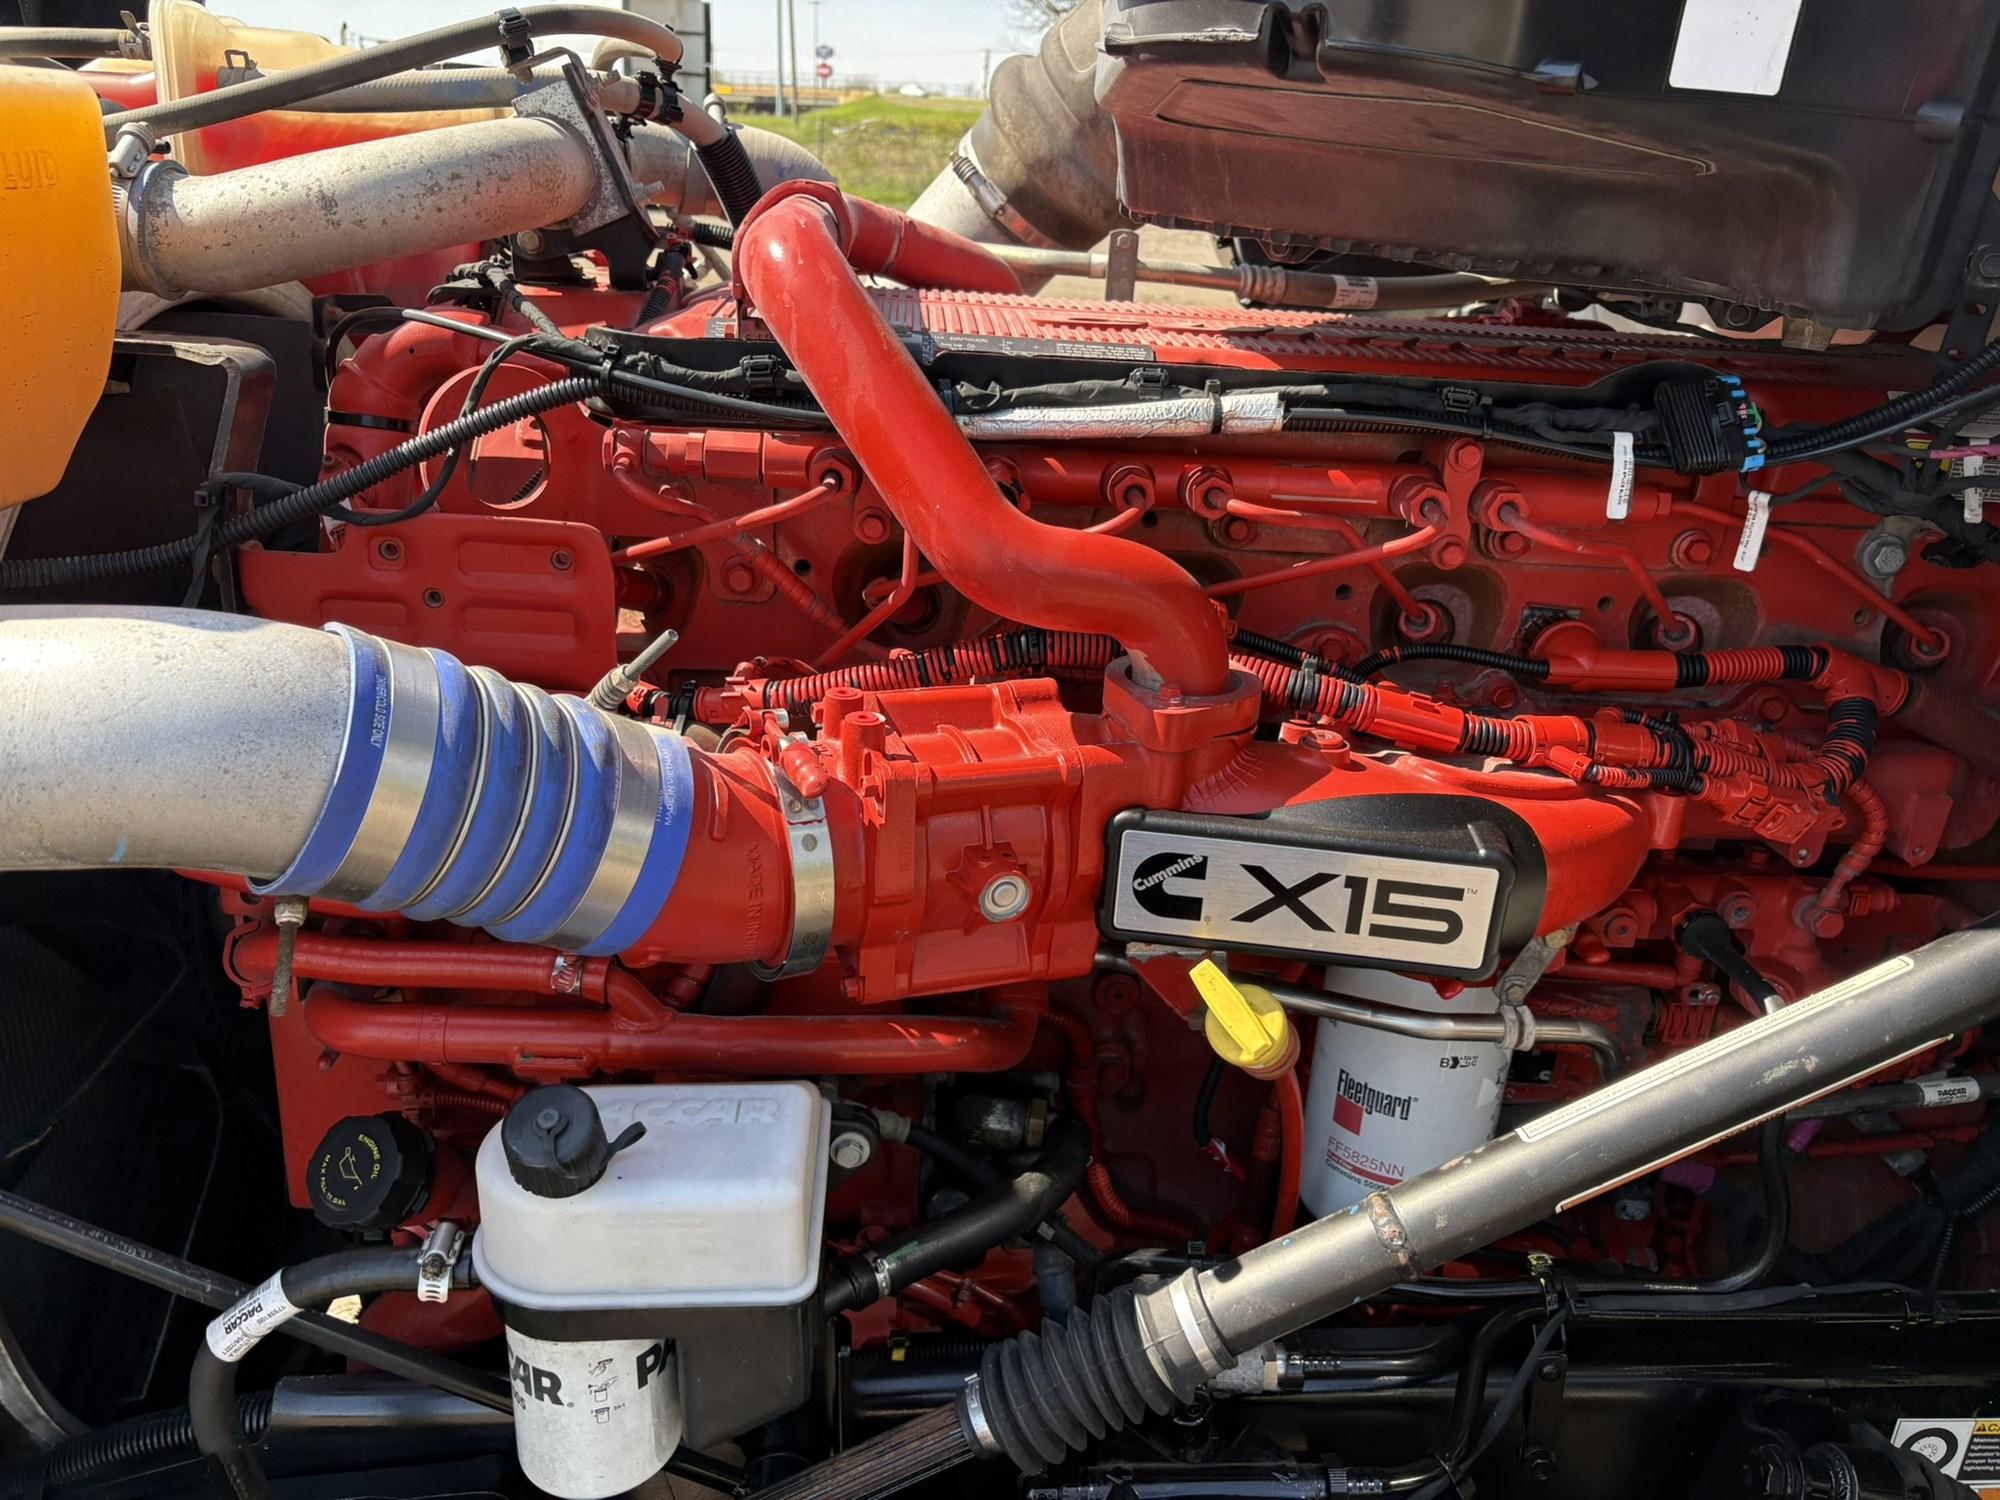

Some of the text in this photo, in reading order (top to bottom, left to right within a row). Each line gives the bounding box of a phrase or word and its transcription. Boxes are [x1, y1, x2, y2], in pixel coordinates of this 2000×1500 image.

[662, 748, 674, 784] VIETNAM
[664, 797, 674, 826] MADE
[747, 843, 763, 899] MADE
[1133, 853, 1204, 892] Cummins
[1230, 863, 1466, 946] X15
[1337, 1068, 1412, 1121] Fleetguard
[1937, 1087, 1967, 1097] PACCAR
[600, 1097, 779, 1126] ACCAR
[321, 1153, 331, 1174] MAX
[358, 1133, 381, 1179] ENGINE OIL
[1325, 1158, 1362, 1185] Cummins
[1327, 1136, 1405, 1177] FF5825NN
[224, 1302, 264, 1335] PACCAR
[508, 1346, 565, 1407] AR
